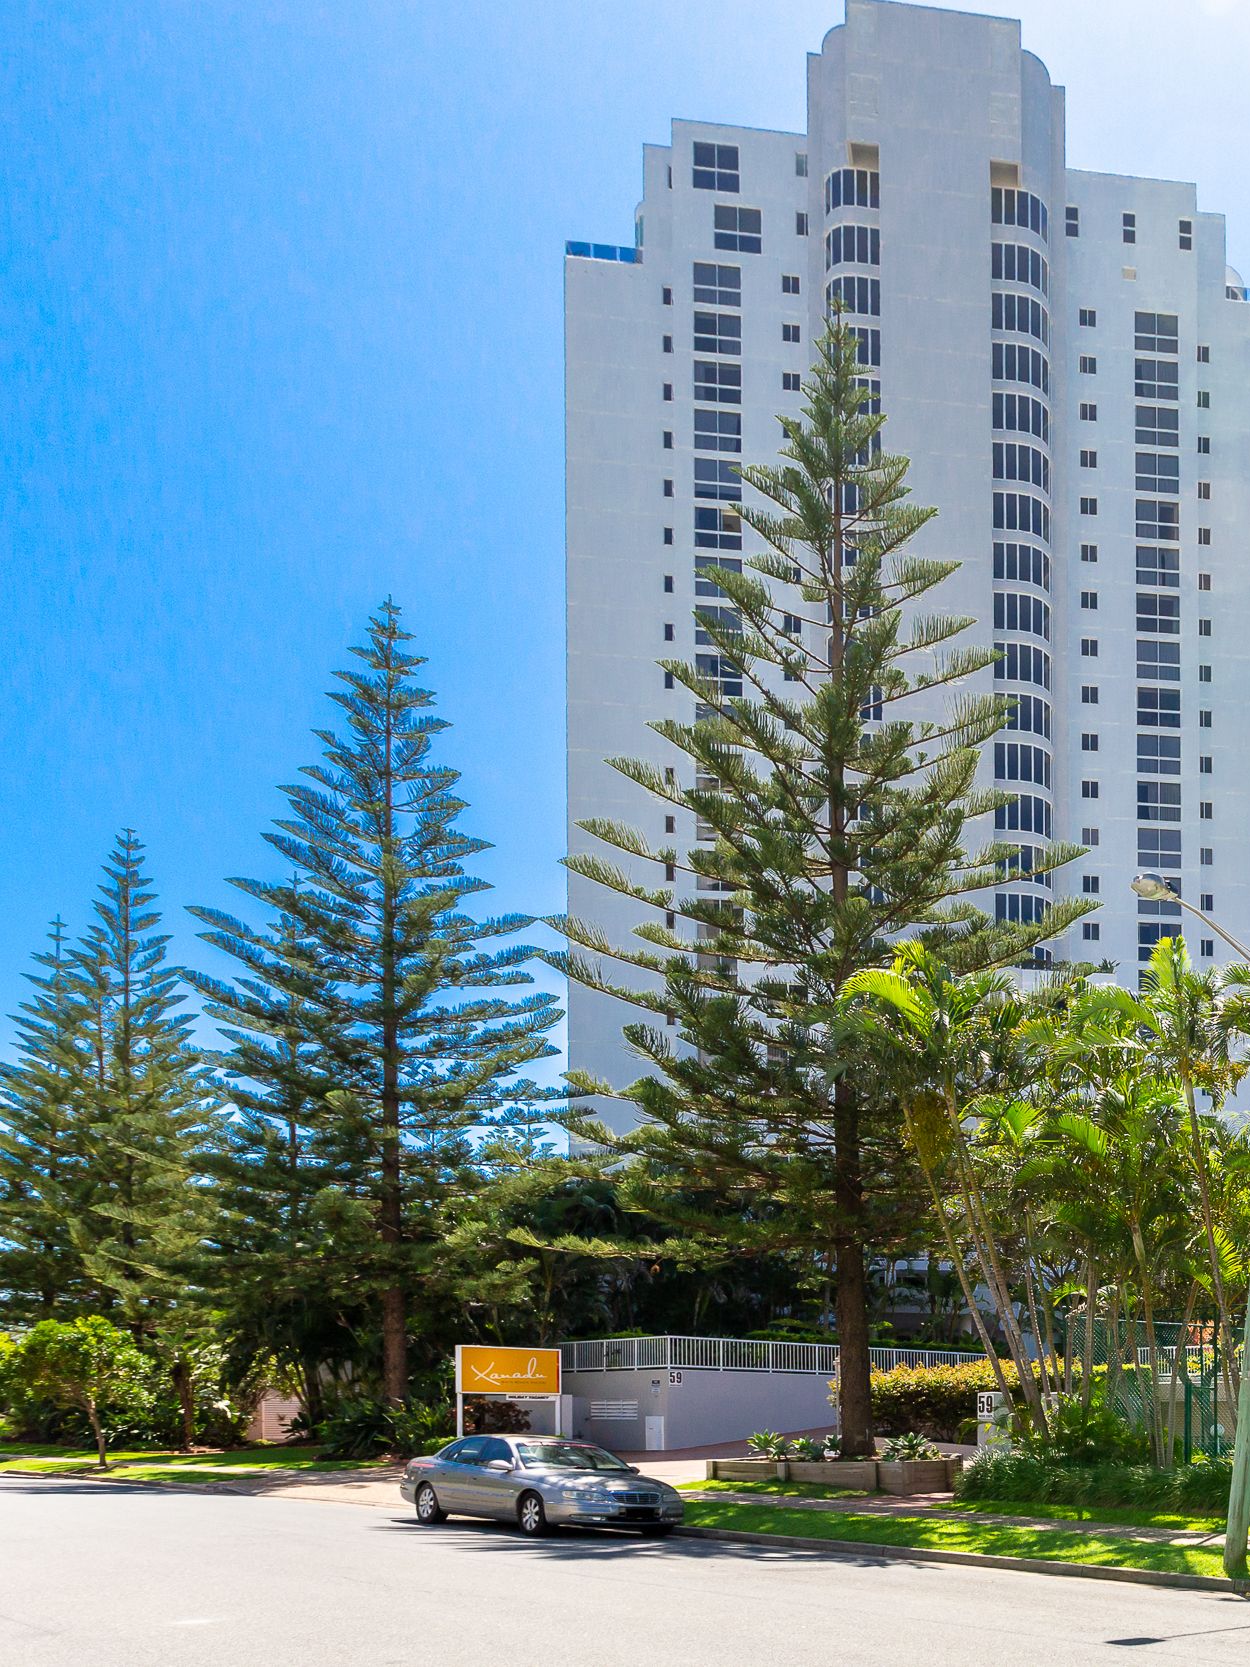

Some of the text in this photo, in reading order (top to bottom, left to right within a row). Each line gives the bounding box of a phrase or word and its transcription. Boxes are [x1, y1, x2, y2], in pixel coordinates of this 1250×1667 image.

[470, 1357, 547, 1386] Xanadu
[669, 1371, 682, 1384] 59
[978, 1395, 993, 1413] 59
